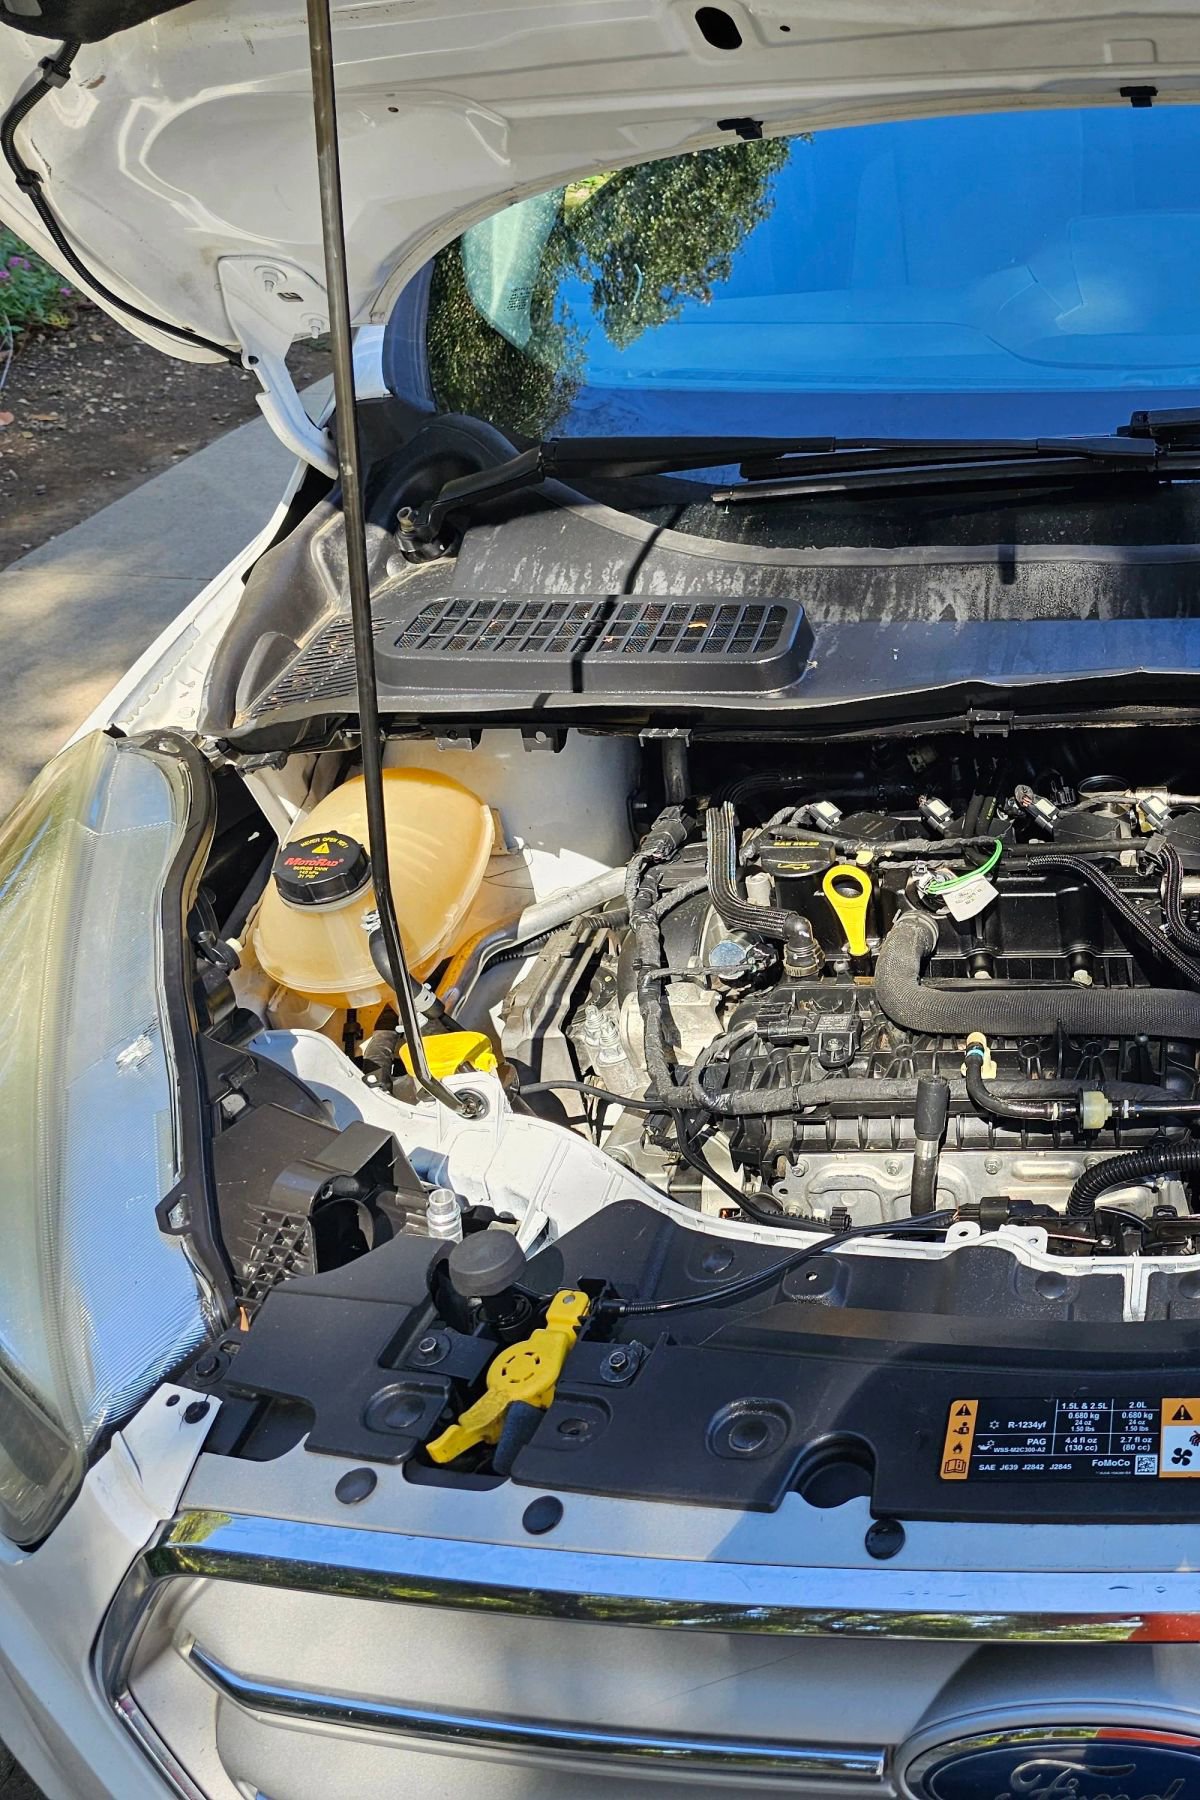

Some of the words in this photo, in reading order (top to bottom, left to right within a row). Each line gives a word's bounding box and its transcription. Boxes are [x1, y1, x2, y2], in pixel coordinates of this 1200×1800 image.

[300, 837, 320, 847] NEVER
[1090, 1412, 1100, 1420] kg
[1143, 1412, 1153, 1420] kg
[1008, 1421, 1047, 1430] R-1234yf
[1065, 1444, 1083, 1452] (130
[1084, 1444, 1098, 1452] cc)
[1122, 1444, 1136, 1452] (80
[1137, 1444, 1151, 1452] cc)
[1092, 1459, 1131, 1467] FoMoCo
